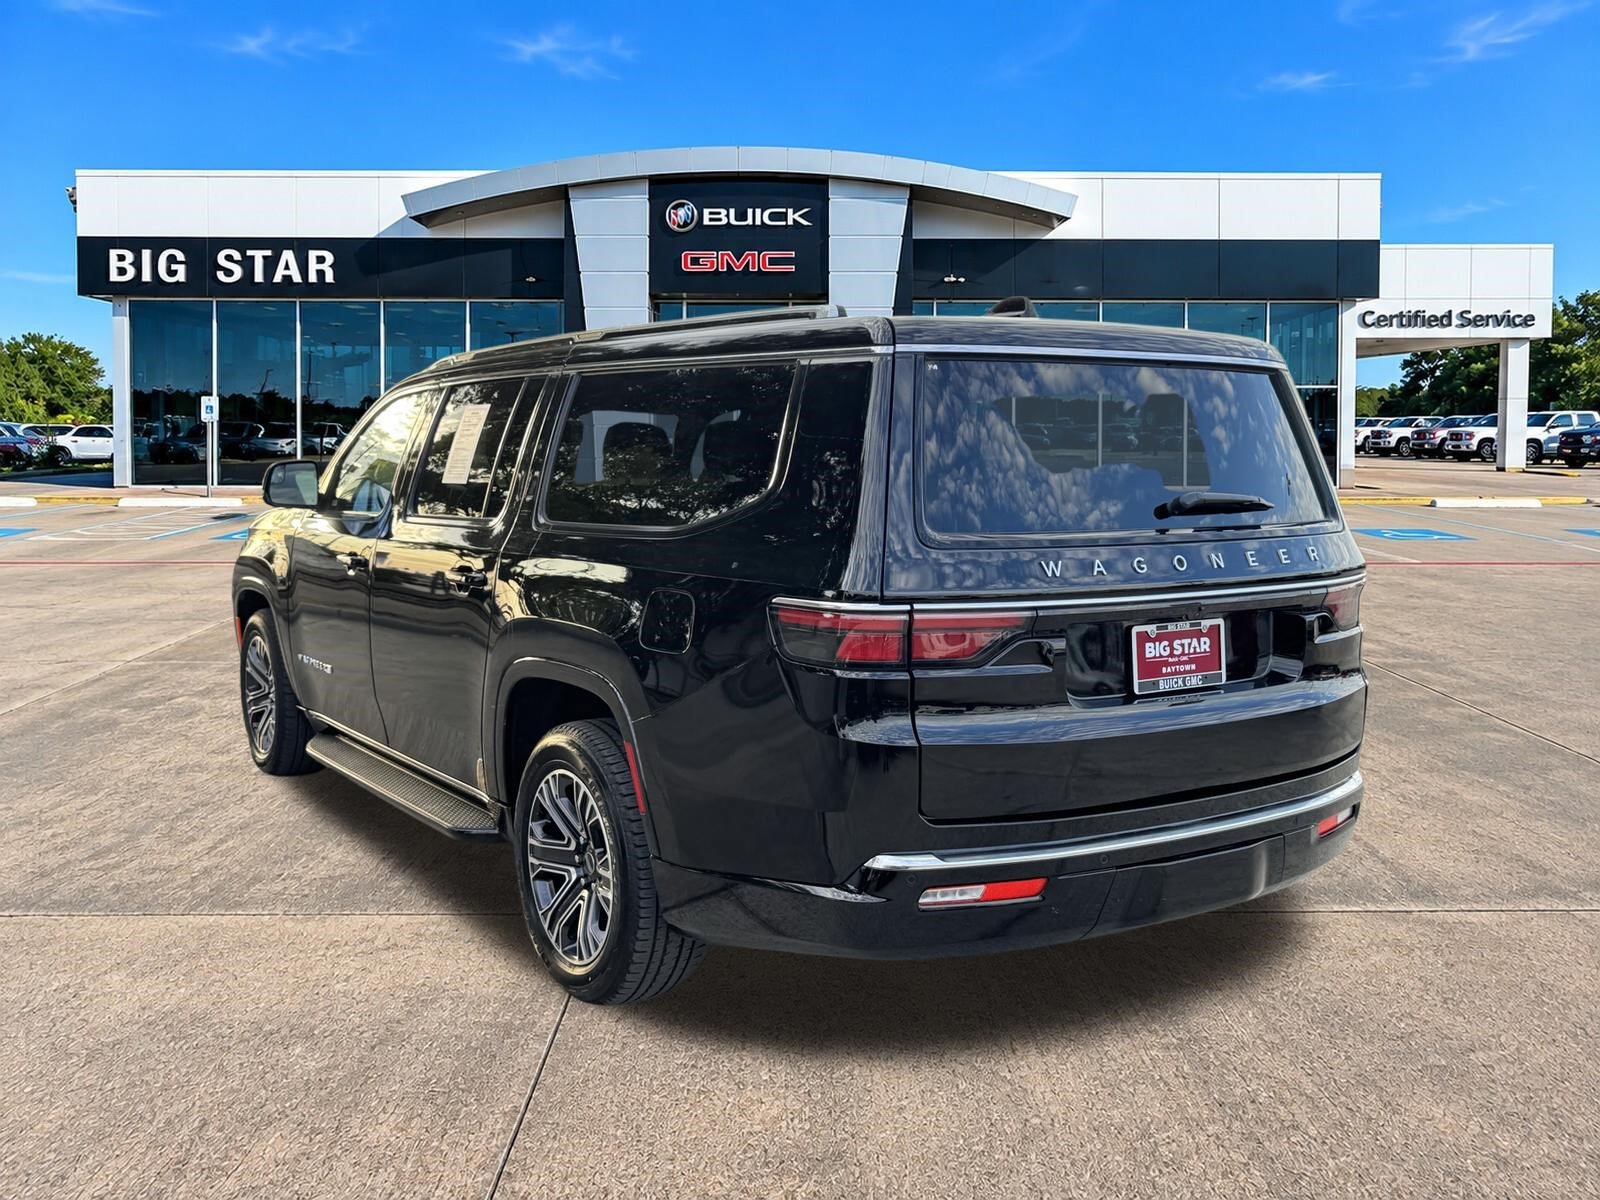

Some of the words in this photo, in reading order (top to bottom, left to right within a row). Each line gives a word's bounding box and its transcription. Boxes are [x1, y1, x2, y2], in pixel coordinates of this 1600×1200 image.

[703, 208, 813, 226] BUICK
[108, 248, 187, 283] BIG
[216, 248, 336, 283] STAR
[681, 251, 796, 272] GMC
[1358, 309, 1453, 329] Certified
[1455, 309, 1536, 329] Service
[1040, 546, 1320, 577] WAGONEER
[1145, 641, 1170, 657] BIG
[1173, 637, 1210, 655] STAR
[1162, 664, 1196, 673] BAYTOWN
[1159, 678, 1184, 689] BUICK
[1185, 676, 1202, 686] GMC
